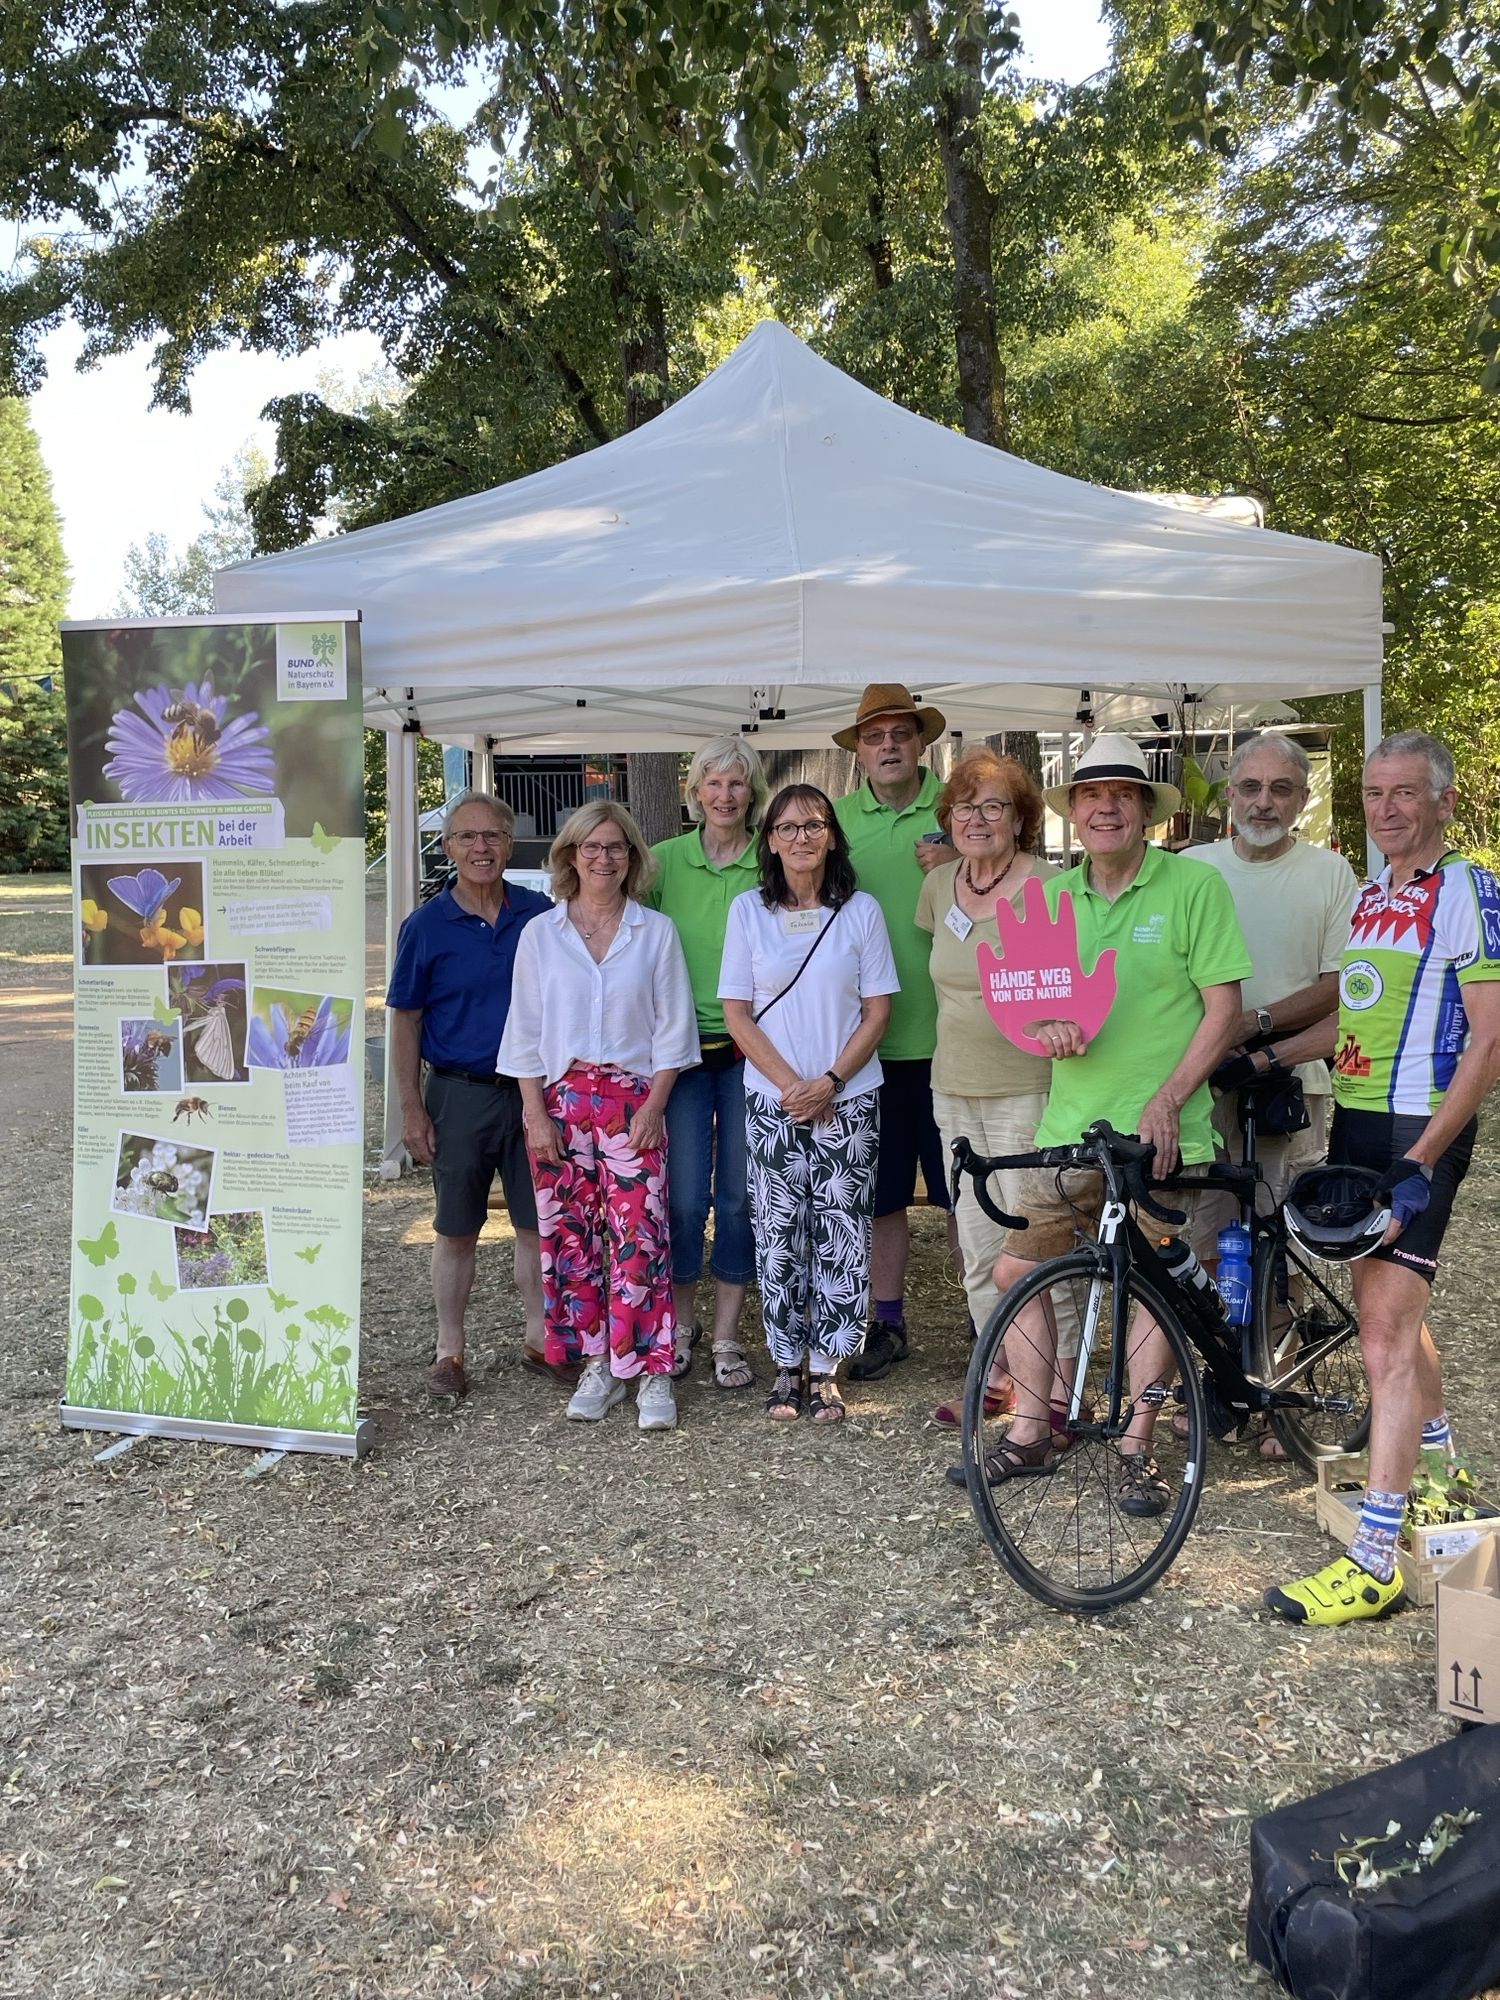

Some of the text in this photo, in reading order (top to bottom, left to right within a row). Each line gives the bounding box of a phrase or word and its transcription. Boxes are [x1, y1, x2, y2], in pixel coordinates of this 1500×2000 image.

[288, 659, 315, 668] BUND
[288, 670, 335, 679] Naturschutz
[288, 680, 335, 691] in Bayern e.V.
[134, 808, 146, 816] FÜR
[87, 819, 257, 849] INSEKTEN bei der
[218, 835, 253, 847] Arbeit
[989, 967, 1072, 990] HÄNDE WEG
[991, 985, 1072, 1003] VON DER NATUR!
